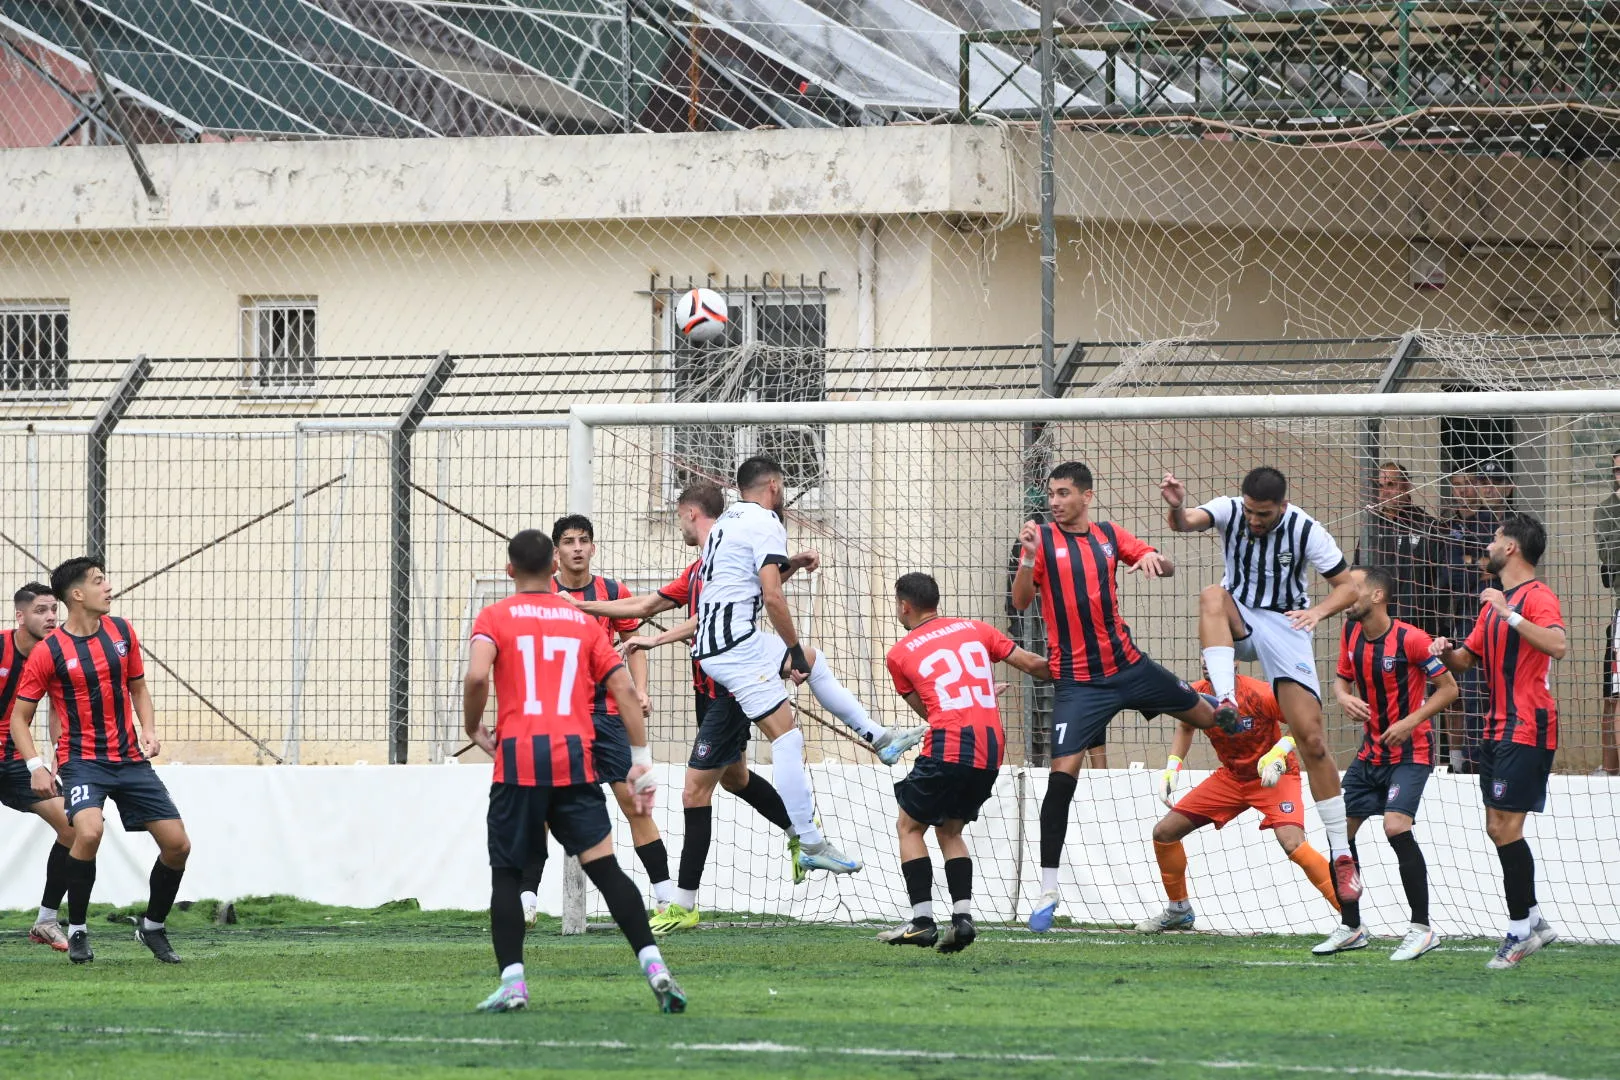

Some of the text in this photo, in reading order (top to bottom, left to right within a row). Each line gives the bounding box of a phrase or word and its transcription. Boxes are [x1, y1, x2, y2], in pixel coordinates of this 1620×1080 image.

[516, 634, 581, 716] 17
[917, 640, 997, 712] 29
[1055, 722, 1068, 745] 7
[70, 784, 90, 806] 21
